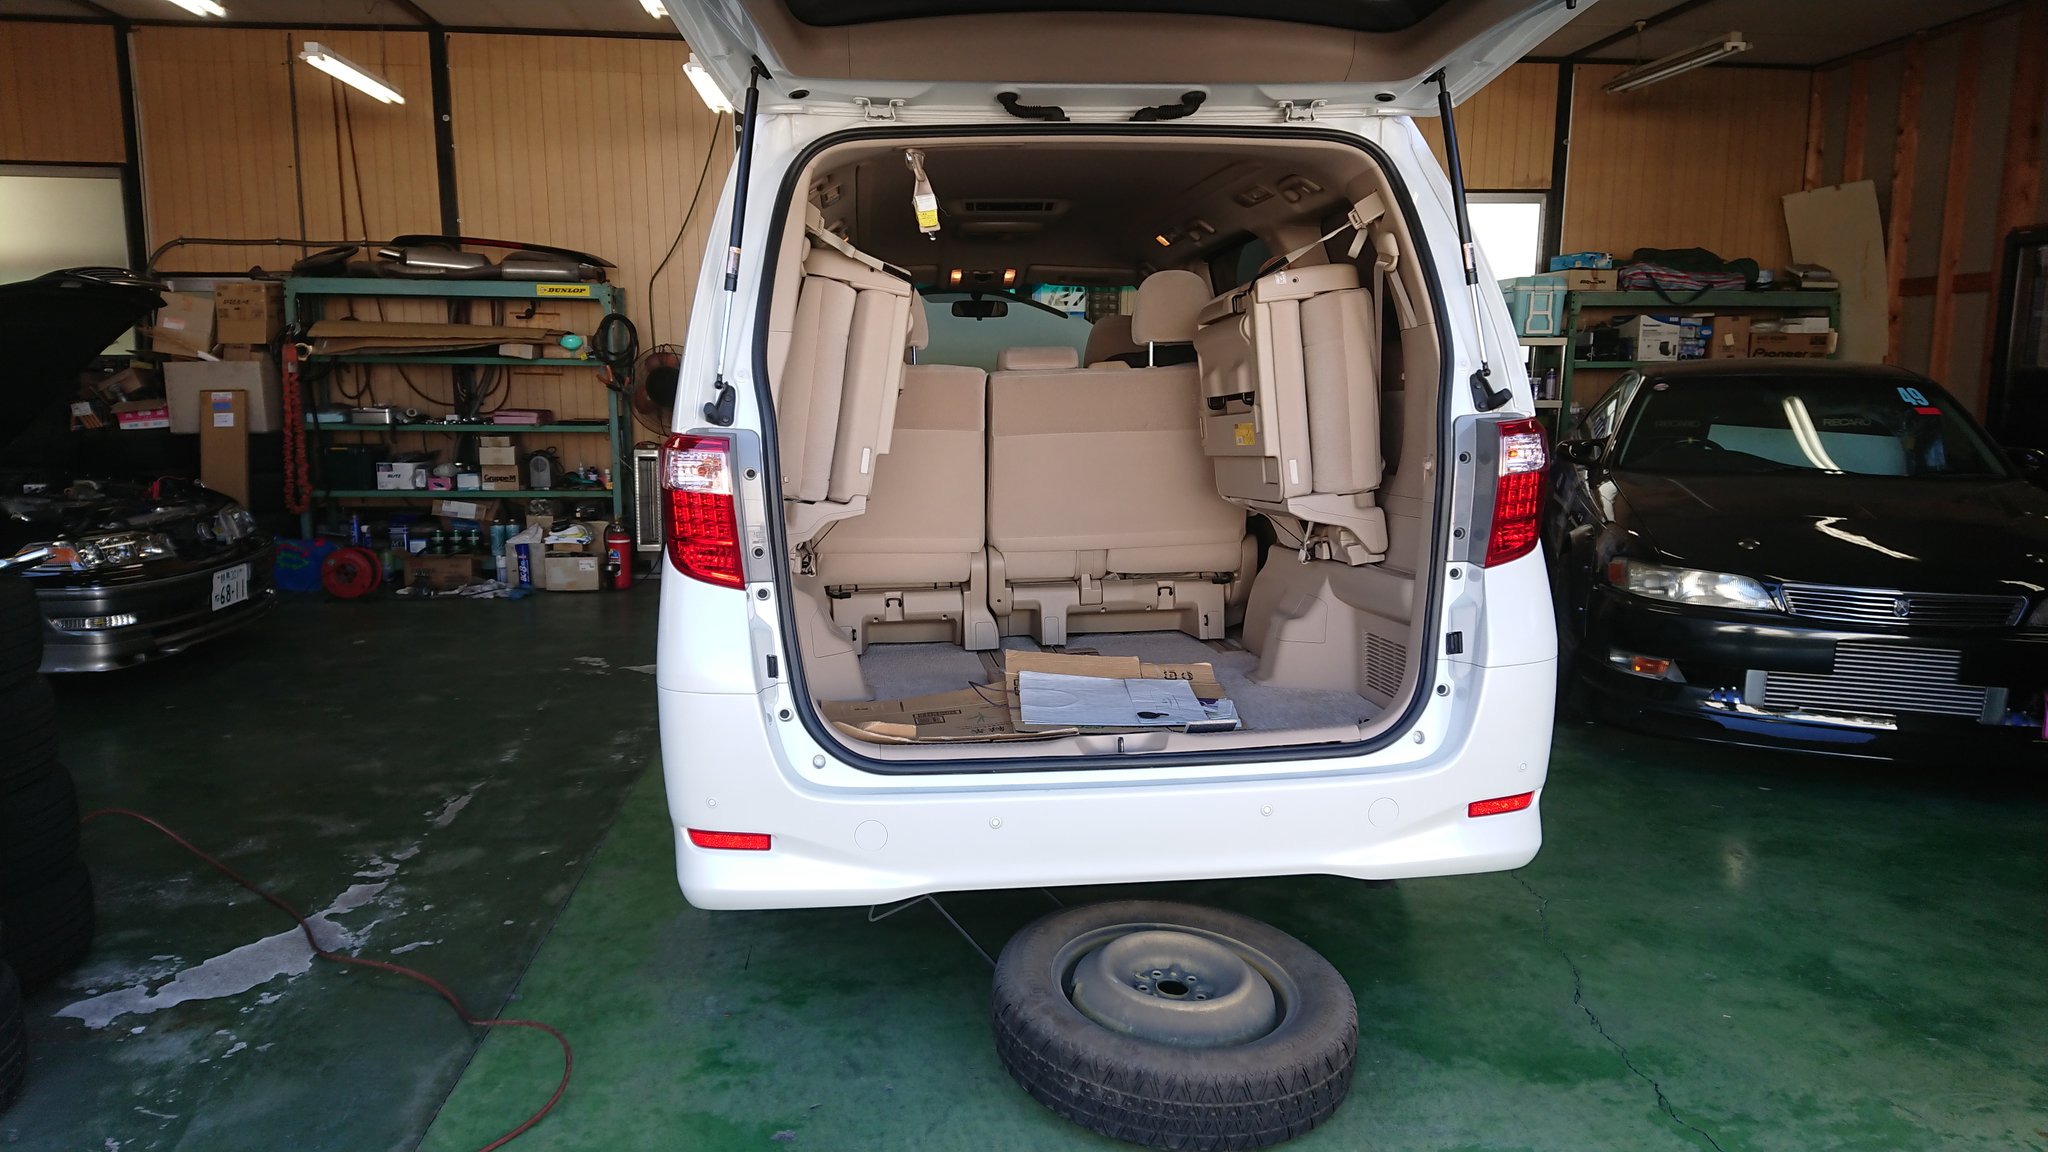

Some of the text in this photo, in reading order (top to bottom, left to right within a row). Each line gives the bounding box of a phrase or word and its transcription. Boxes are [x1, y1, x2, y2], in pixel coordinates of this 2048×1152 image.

[1753, 348, 1808, 358] Pioneer
[1896, 387, 1930, 406] 49
[1823, 418, 1872, 427] RECARO
